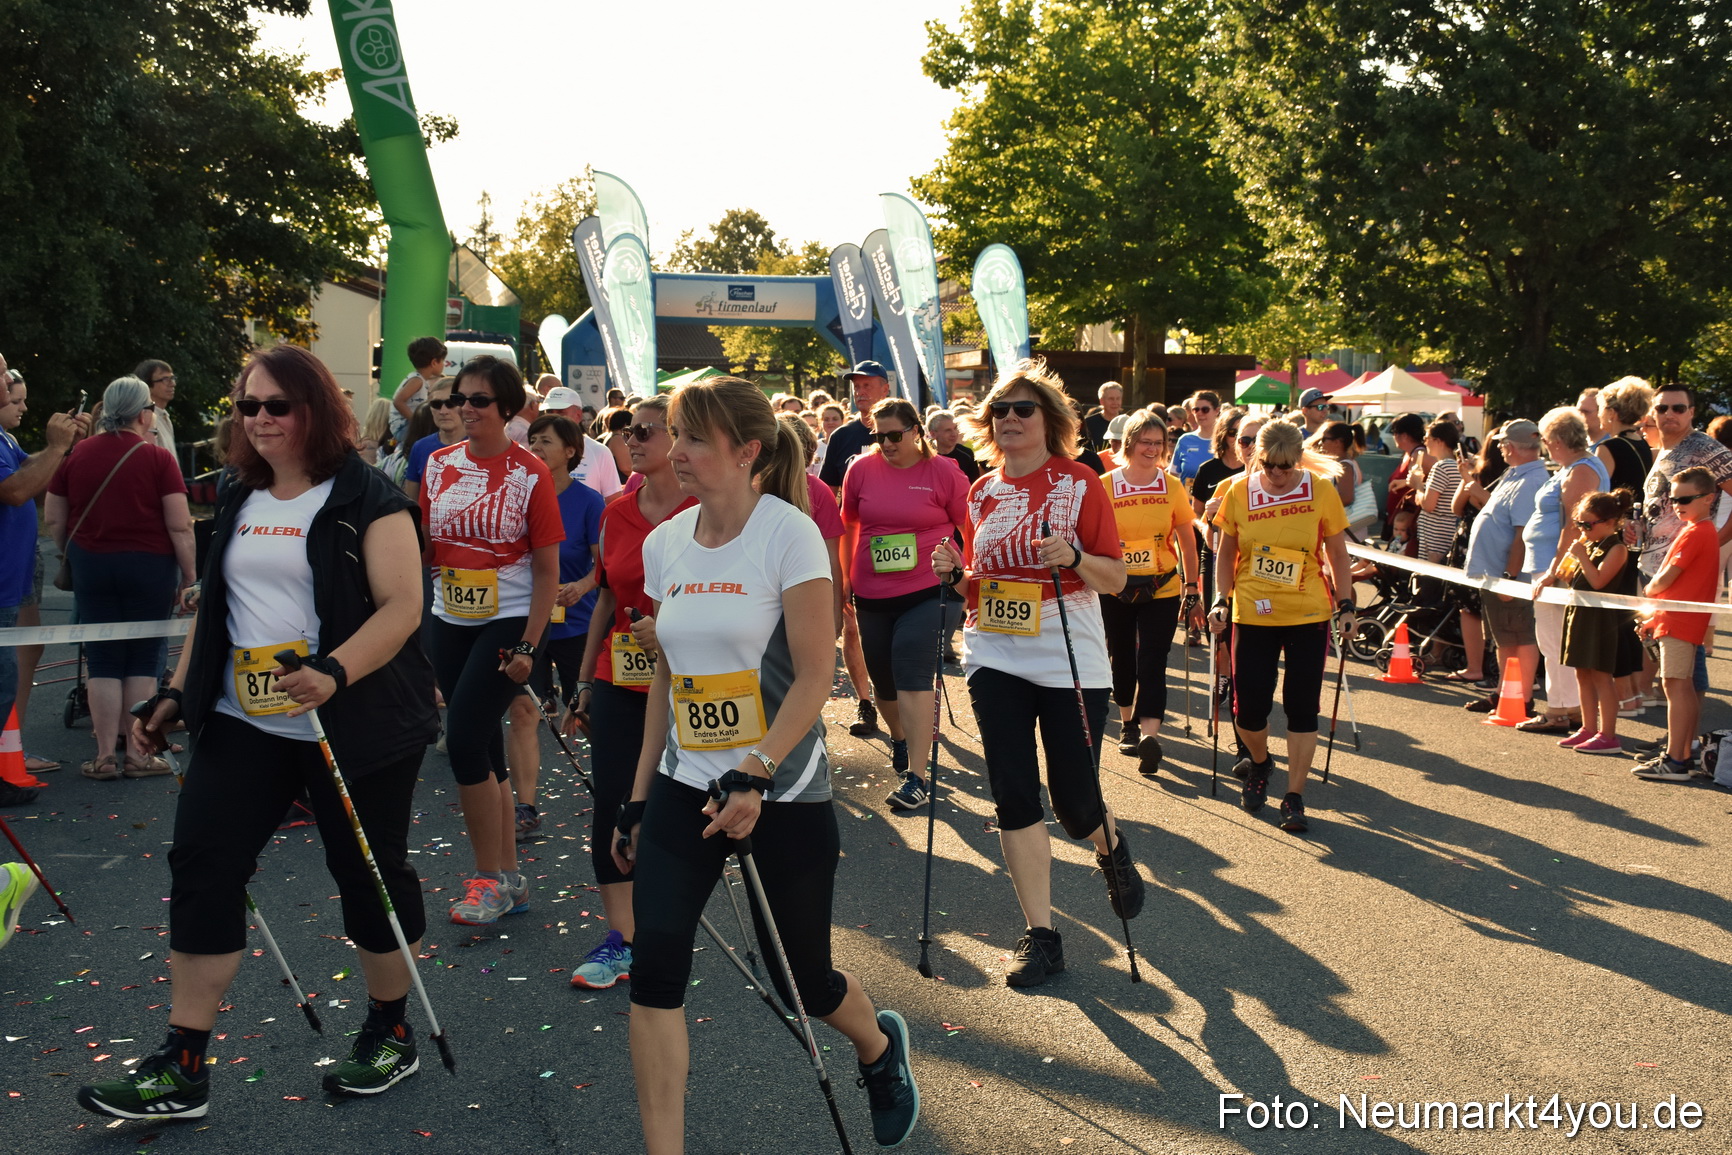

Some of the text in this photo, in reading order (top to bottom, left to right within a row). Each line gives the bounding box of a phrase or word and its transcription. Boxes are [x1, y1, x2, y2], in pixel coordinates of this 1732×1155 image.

[342, 0, 417, 120] AOK
[718, 301, 778, 313] firmenlauf
[1114, 496, 1169, 509] MAX BÖGL
[1248, 504, 1315, 522] MAX BÖGL
[252, 526, 306, 538] KLEBL
[875, 547, 911, 562] 2064
[1125, 551, 1150, 564] 302
[1256, 557, 1294, 577] 1301
[446, 584, 488, 605] 1847
[684, 582, 748, 595] KLEBL
[985, 598, 1031, 620] 1859
[246, 671, 287, 697] 87
[249, 697, 275, 705] Dobmann
[688, 700, 739, 730] 880
[694, 728, 739, 738] Endres Katja
